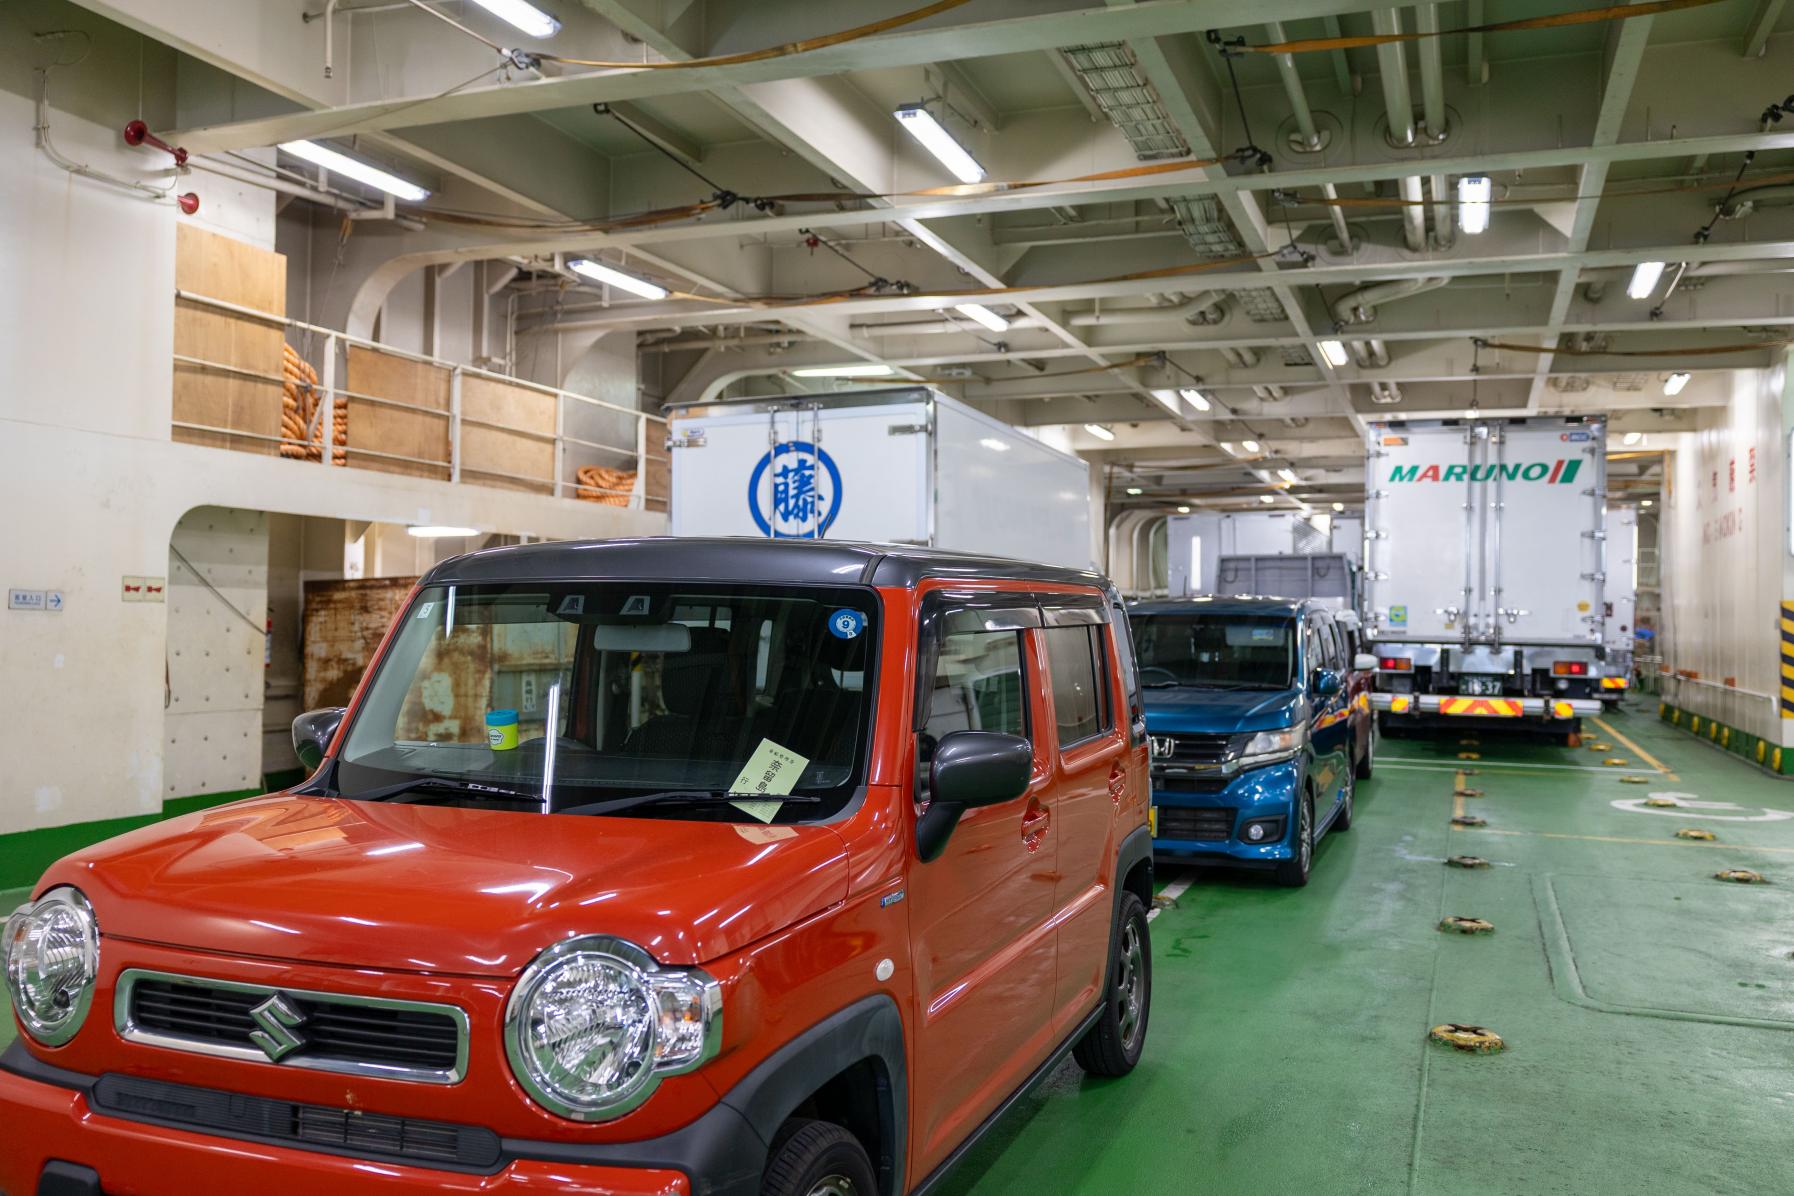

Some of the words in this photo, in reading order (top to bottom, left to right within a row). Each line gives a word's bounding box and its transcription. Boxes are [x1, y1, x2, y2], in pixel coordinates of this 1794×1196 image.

[1388, 462, 1550, 483] MARUNO
[772, 458, 825, 523] 藤
[740, 777, 749, 785] 行
[756, 760, 783, 793] 奈留島
